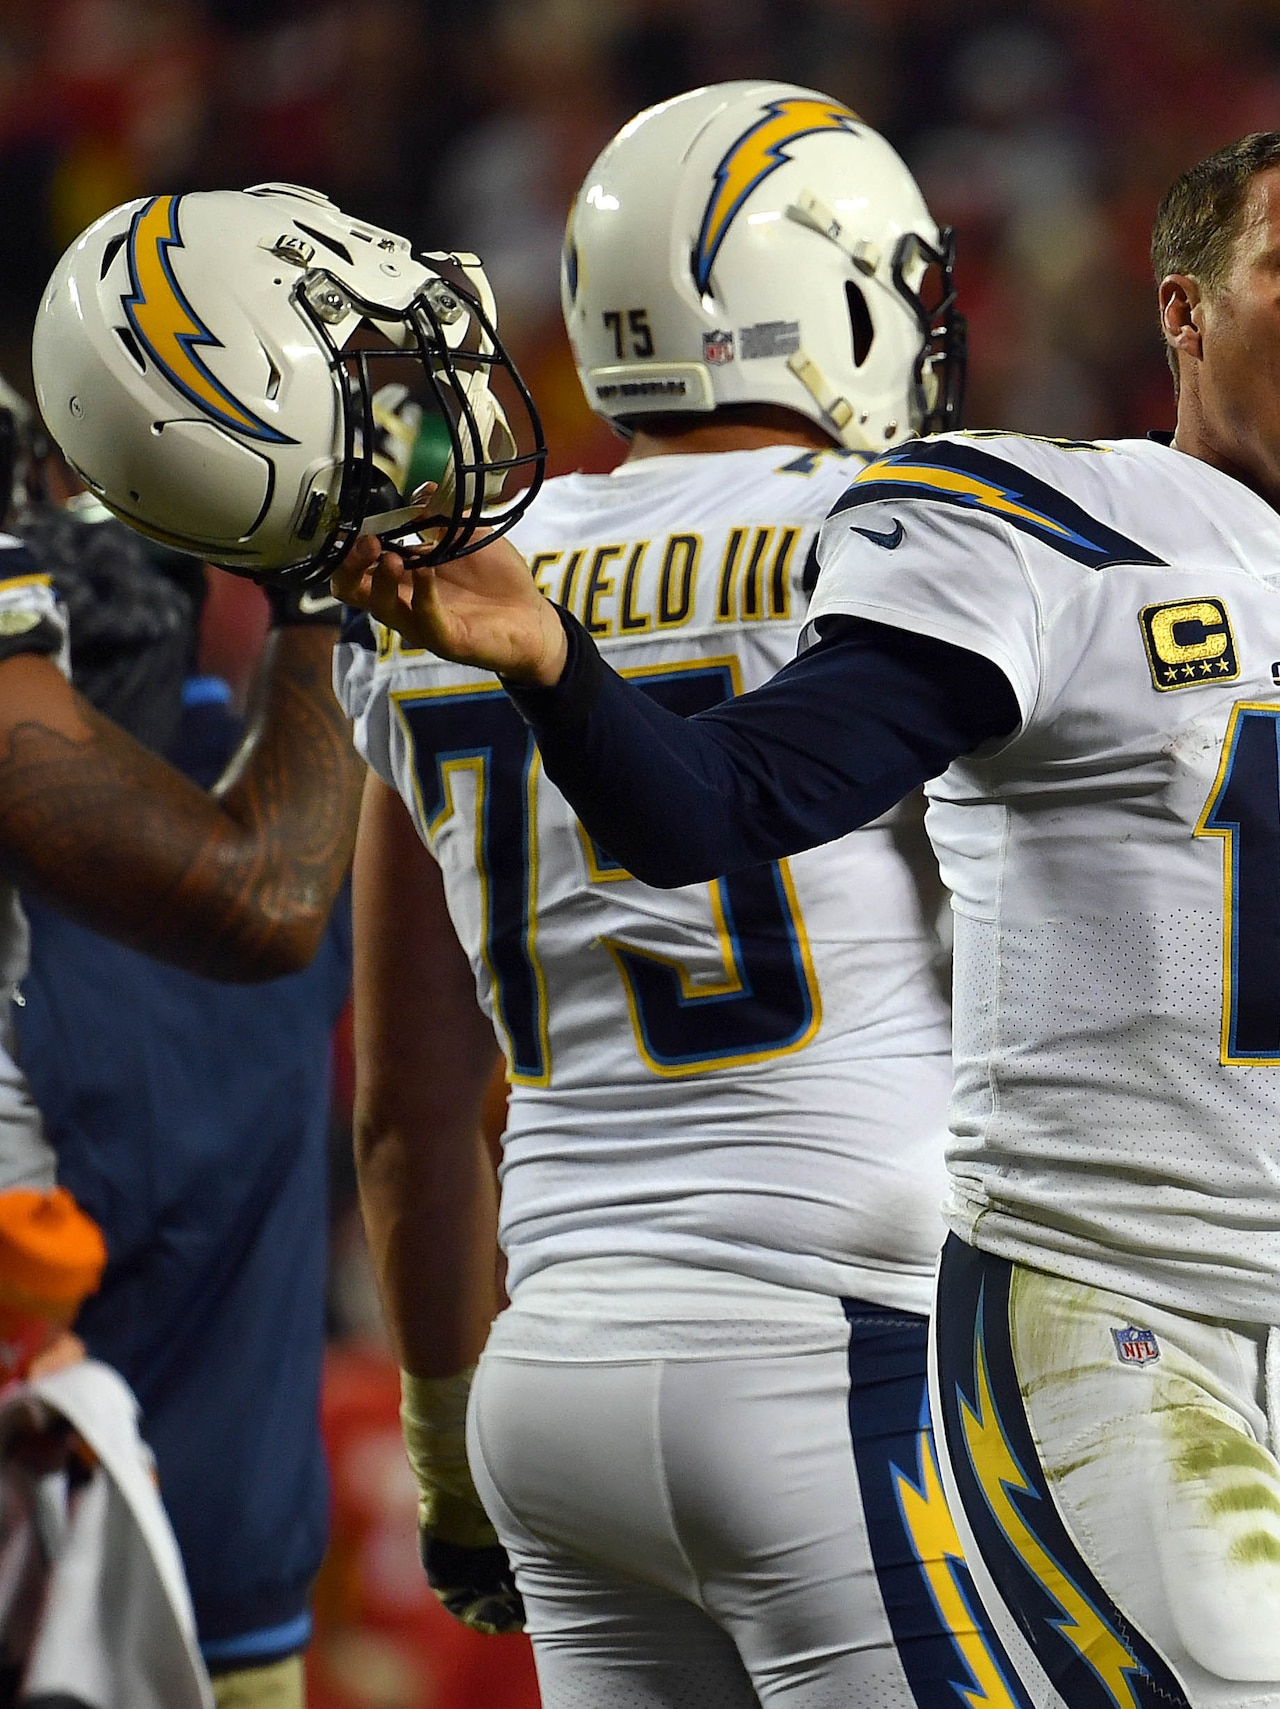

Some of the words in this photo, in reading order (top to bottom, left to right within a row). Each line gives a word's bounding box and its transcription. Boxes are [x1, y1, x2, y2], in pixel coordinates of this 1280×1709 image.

[603, 309, 656, 360] 75
[715, 526, 801, 623] III
[1152, 602, 1229, 664] C
[1122, 1341, 1156, 1360] NFL
